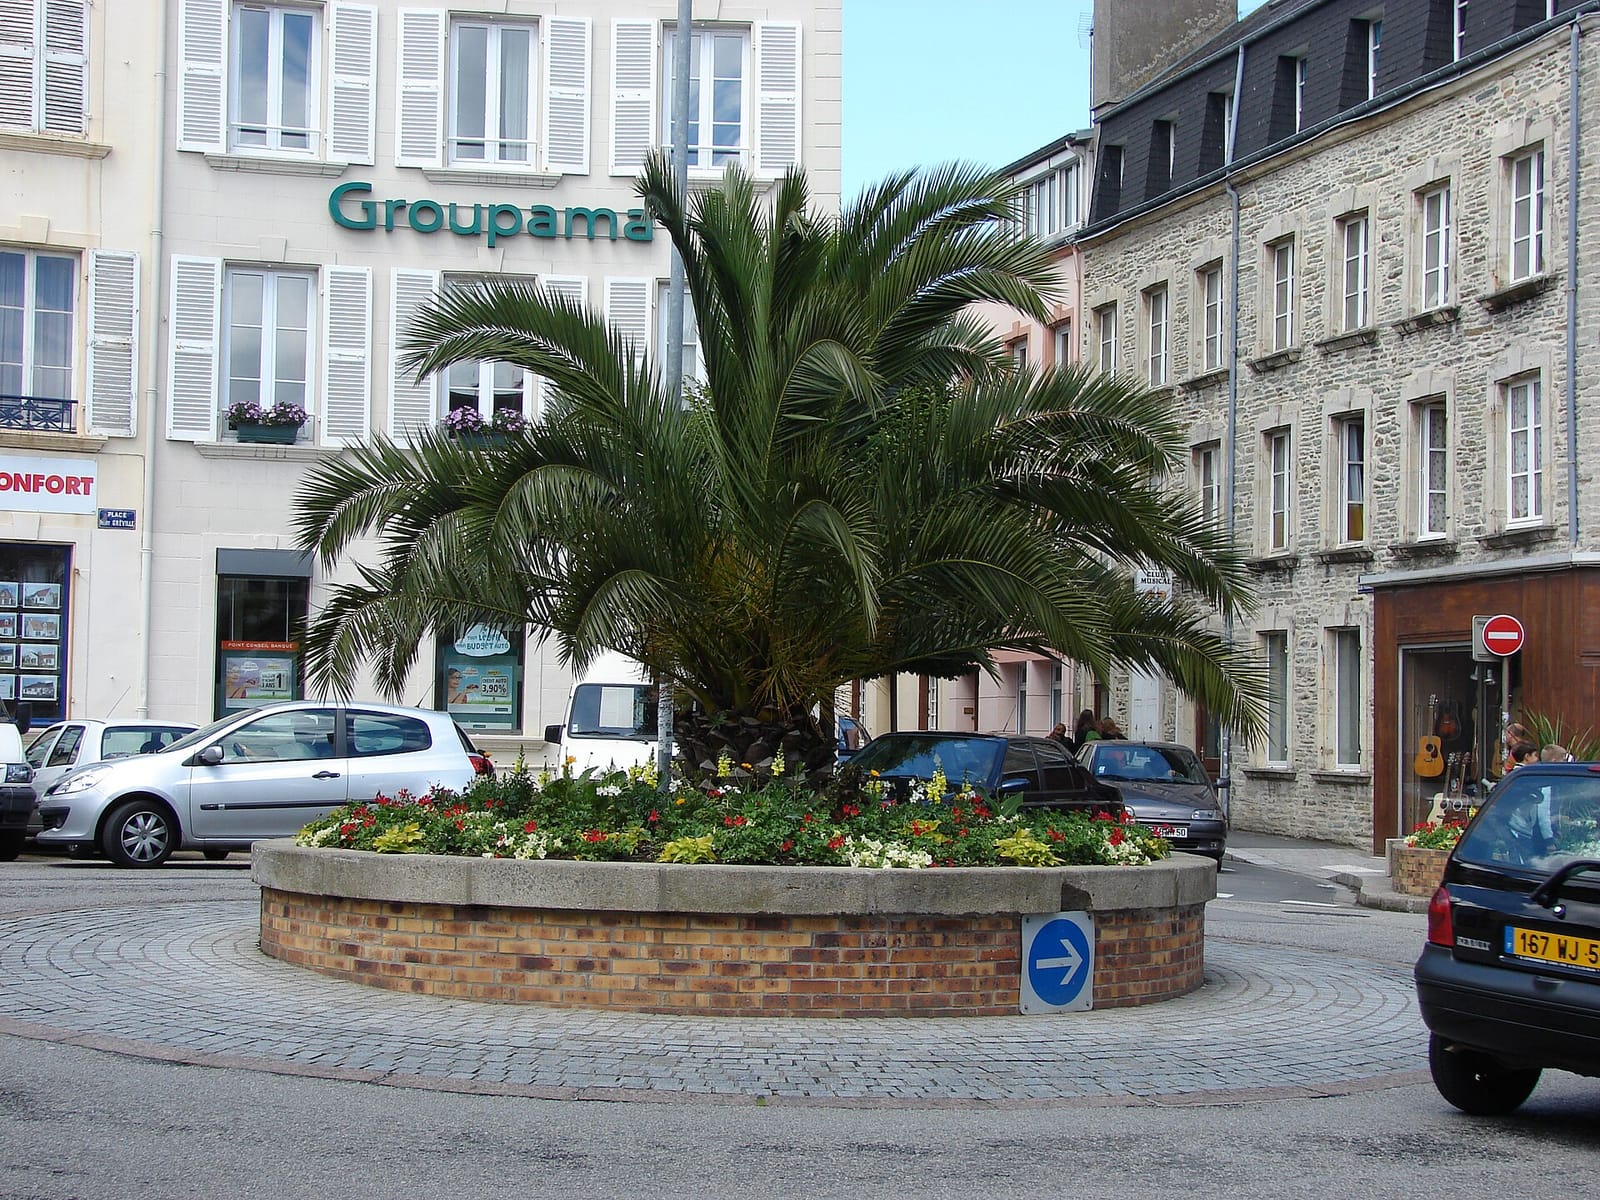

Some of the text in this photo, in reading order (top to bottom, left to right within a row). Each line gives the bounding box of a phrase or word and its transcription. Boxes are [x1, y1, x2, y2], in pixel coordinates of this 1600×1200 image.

[328, 181, 653, 248] Groupama
[482, 684, 507, 694] 3,90%
[1520, 933, 1549, 955] 167
[1558, 939, 1579, 961] WJ
